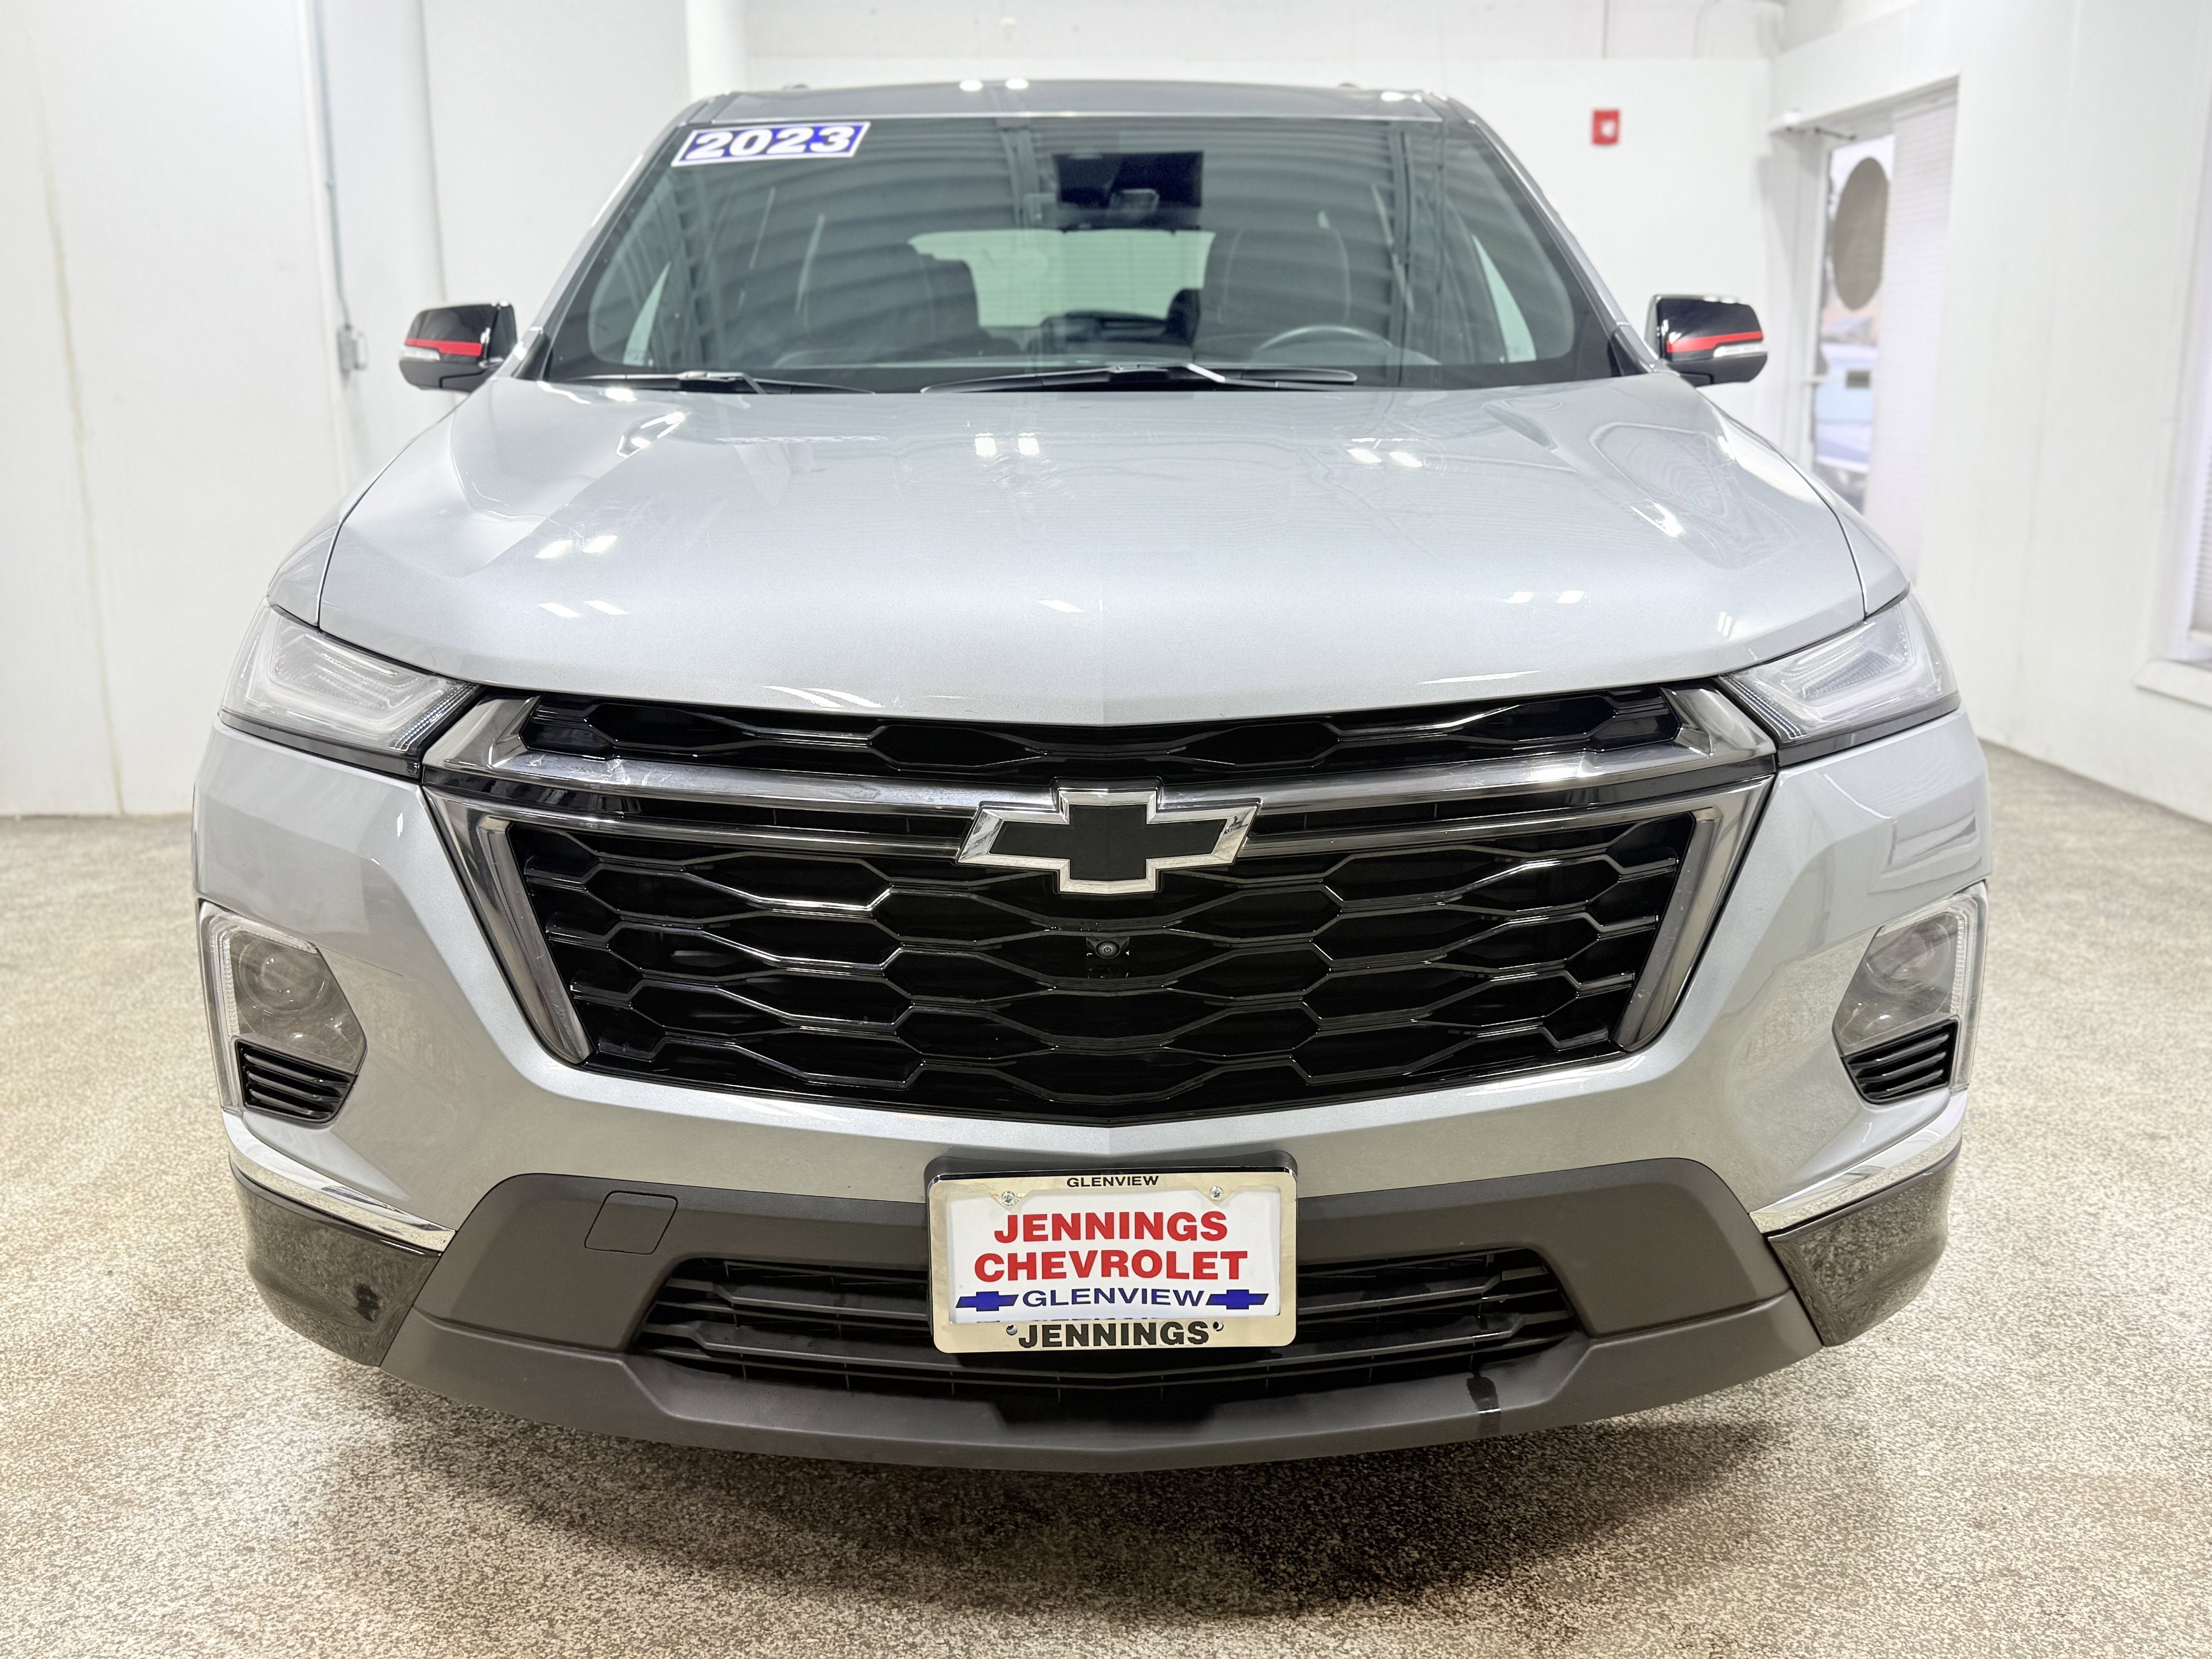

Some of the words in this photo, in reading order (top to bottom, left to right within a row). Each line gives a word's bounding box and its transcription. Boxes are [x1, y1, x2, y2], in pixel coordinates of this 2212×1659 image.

[685, 126, 855, 160] 2023
[1066, 1175, 1159, 1187] GLENVIEW
[994, 1211, 1228, 1244] JENNINGS
[974, 1250, 1248, 1282] CHEVROLET
[1022, 1288, 1204, 1307] GLENVIEW
[1018, 1321, 1209, 1348] JENNINGS
